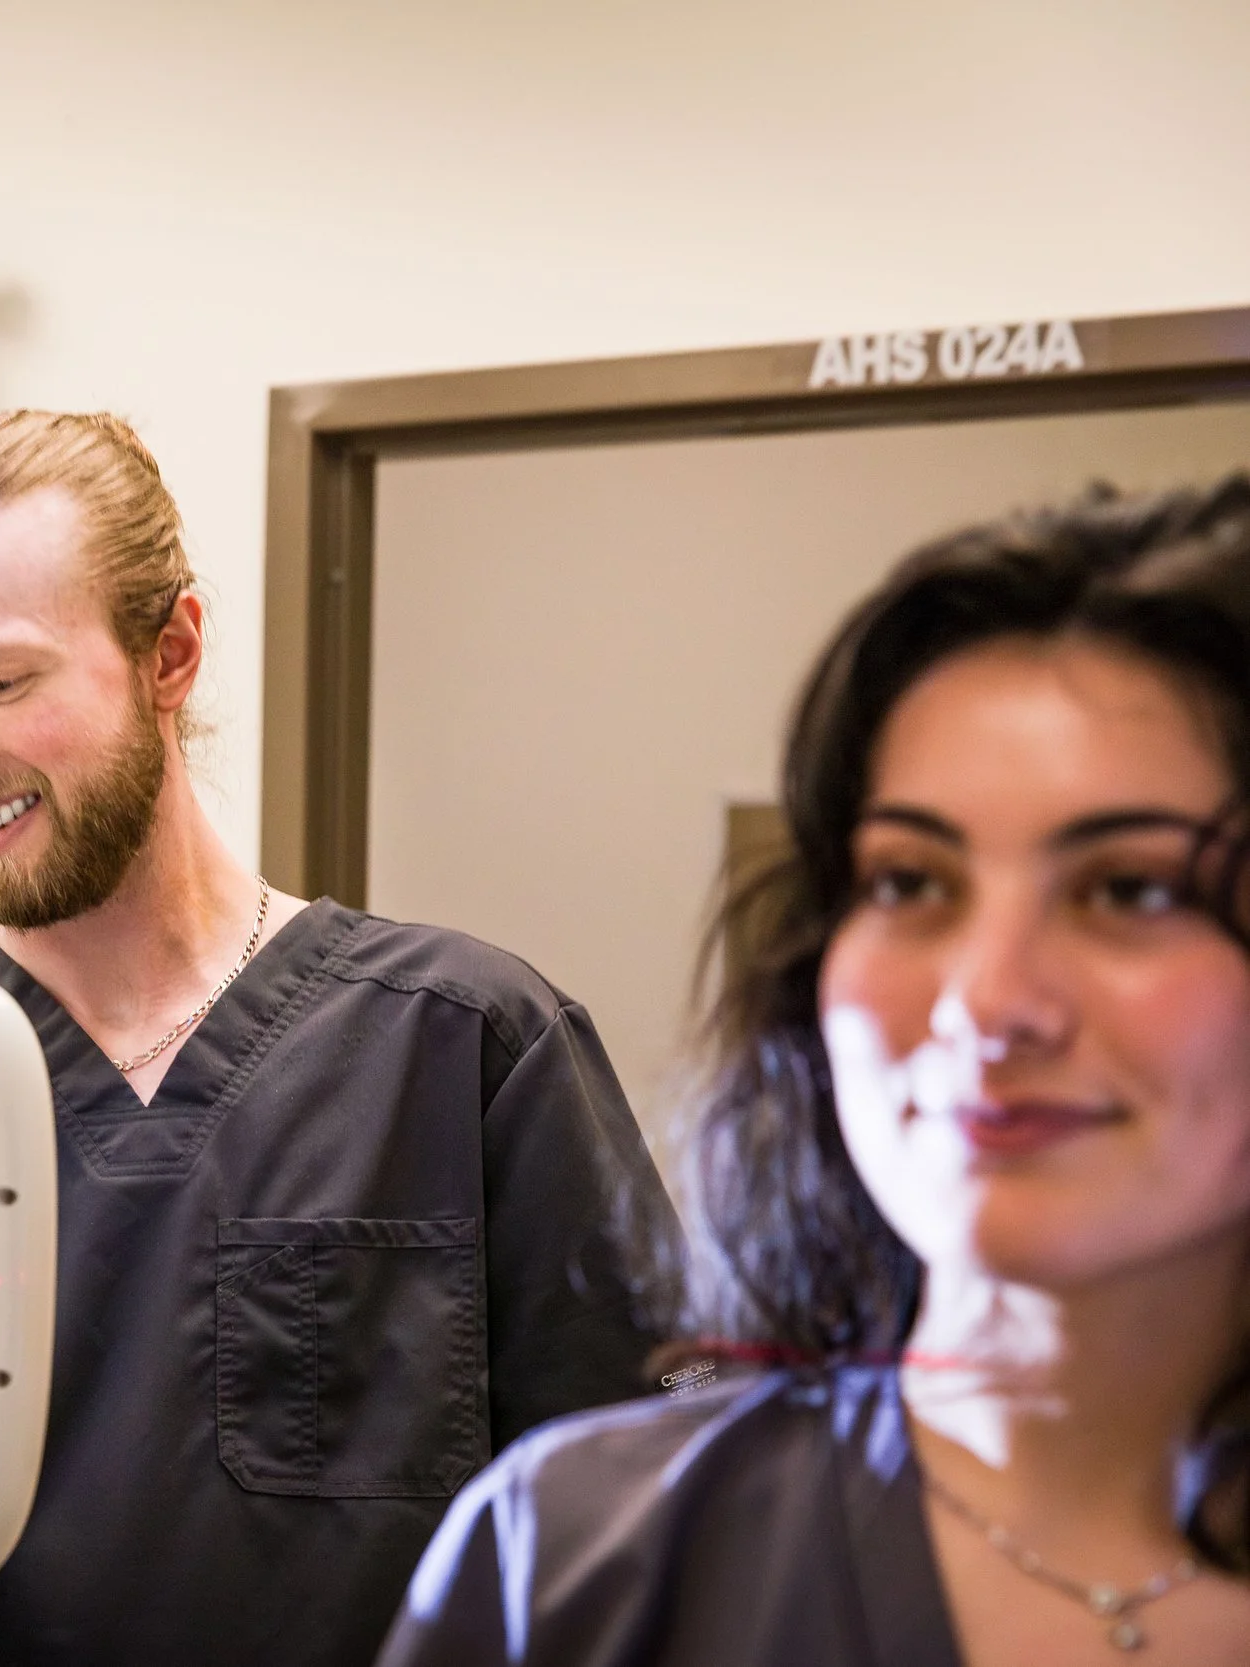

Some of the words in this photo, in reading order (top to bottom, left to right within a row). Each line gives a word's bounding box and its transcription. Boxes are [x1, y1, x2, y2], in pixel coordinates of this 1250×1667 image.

[808, 327, 929, 389] AHS
[937, 319, 1085, 381] 024A
[661, 1360, 716, 1387] CHEROKEE
